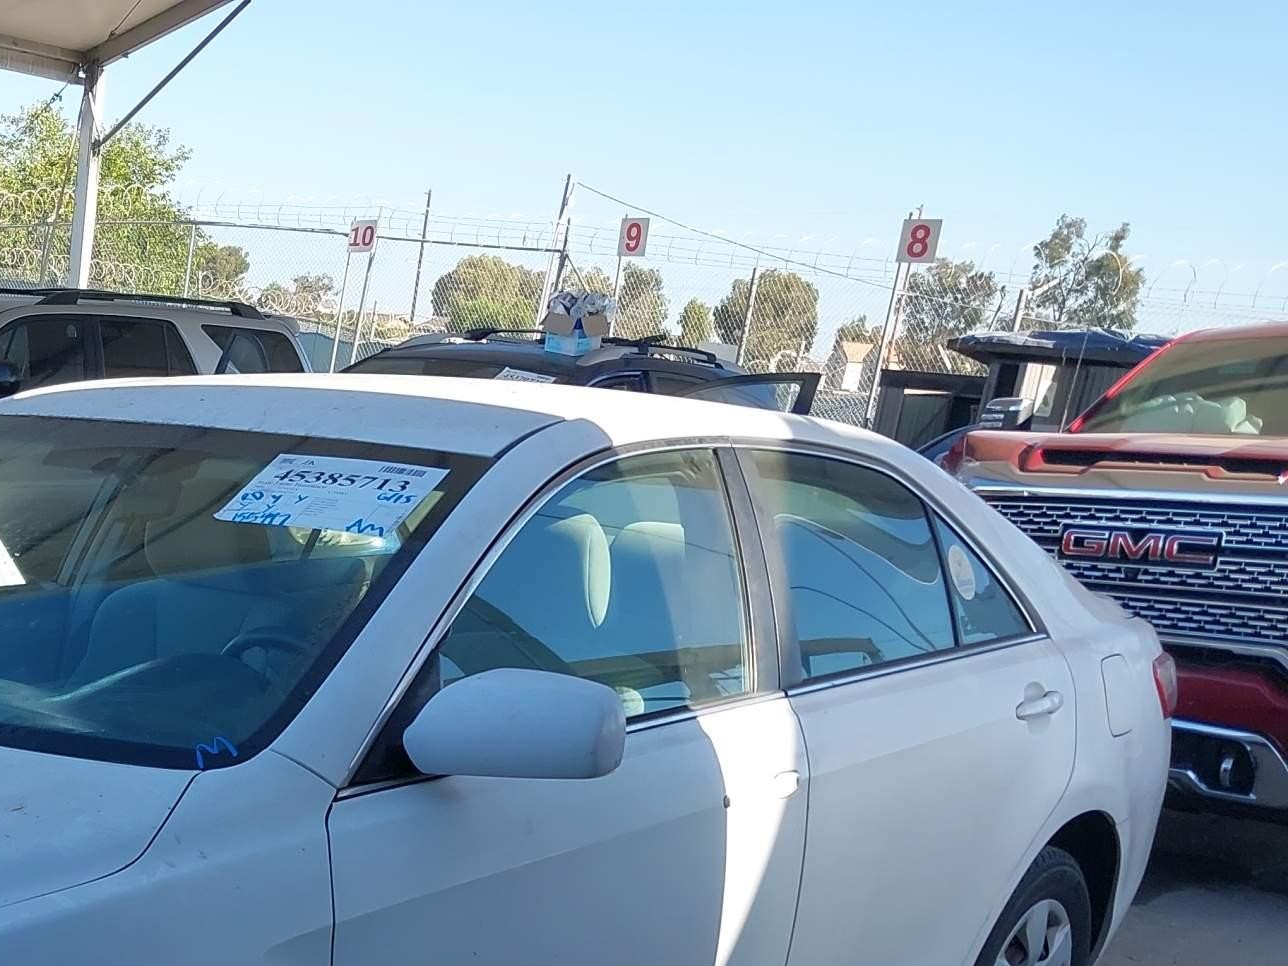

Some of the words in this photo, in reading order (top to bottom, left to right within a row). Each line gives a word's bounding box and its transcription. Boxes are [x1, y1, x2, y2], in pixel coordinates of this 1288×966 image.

[349, 225, 375, 247] 10
[625, 222, 642, 252] 9
[906, 224, 931, 258] 8
[274, 469, 411, 493] 45385713
[1062, 528, 1219, 565] GMC
